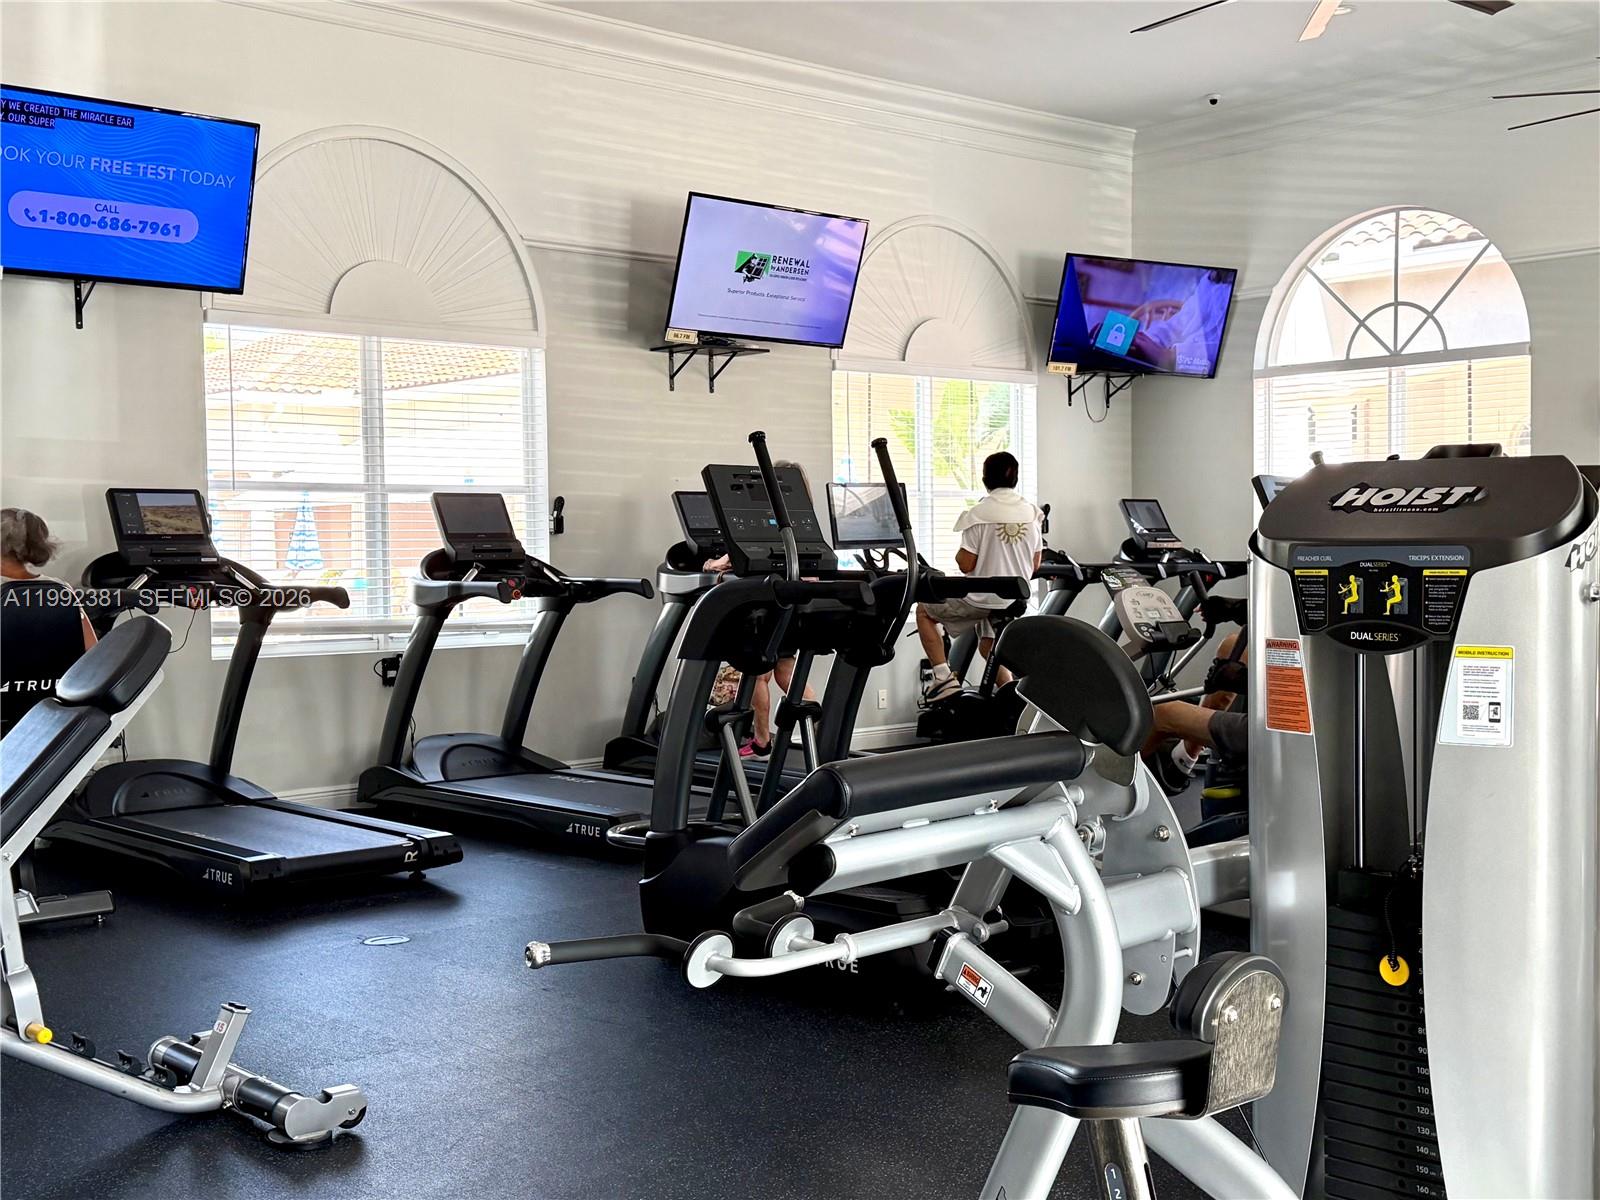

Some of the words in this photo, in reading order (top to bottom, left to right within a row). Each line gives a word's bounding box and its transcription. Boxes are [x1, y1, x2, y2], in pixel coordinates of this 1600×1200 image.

[9, 101, 21, 111] WE
[24, 102, 60, 116] CREATED
[63, 108, 78, 119] THE
[80, 111, 114, 125] MIRACLE
[116, 117, 132, 127] EAR
[8, 113, 26, 124] OUR
[29, 115, 55, 127] SUPER
[0, 145, 31, 163] OK
[36, 150, 85, 170] YOUR
[90, 156, 132, 176] FREE
[137, 163, 177, 181] TEST
[180, 168, 236, 189] TODAY
[94, 203, 120, 214] CALL
[39, 209, 181, 238] 1-800-686-7961
[772, 256, 811, 268] RENEWAL
[776, 266, 810, 276] ANDERSEN
[1333, 486, 1477, 507] HOIST
[1350, 631, 1373, 641] DUAL
[574, 823, 601, 838] TRUE
[210, 869, 233, 885] TRUE
[216, 1022, 225, 1032] 15
[1418, 1046, 1428, 1055] 90
[1416, 1066, 1430, 1076] 100
[1417, 1086, 1430, 1095] 110
[1416, 1106, 1430, 1115] 120
[1417, 1126, 1430, 1135] 130
[1416, 1145, 1429, 1155] 140
[1110, 1168, 1117, 1180] 1
[1416, 1164, 1429, 1174] 150
[1114, 1188, 1122, 1200] 2
[1416, 1184, 1429, 1194] 160
